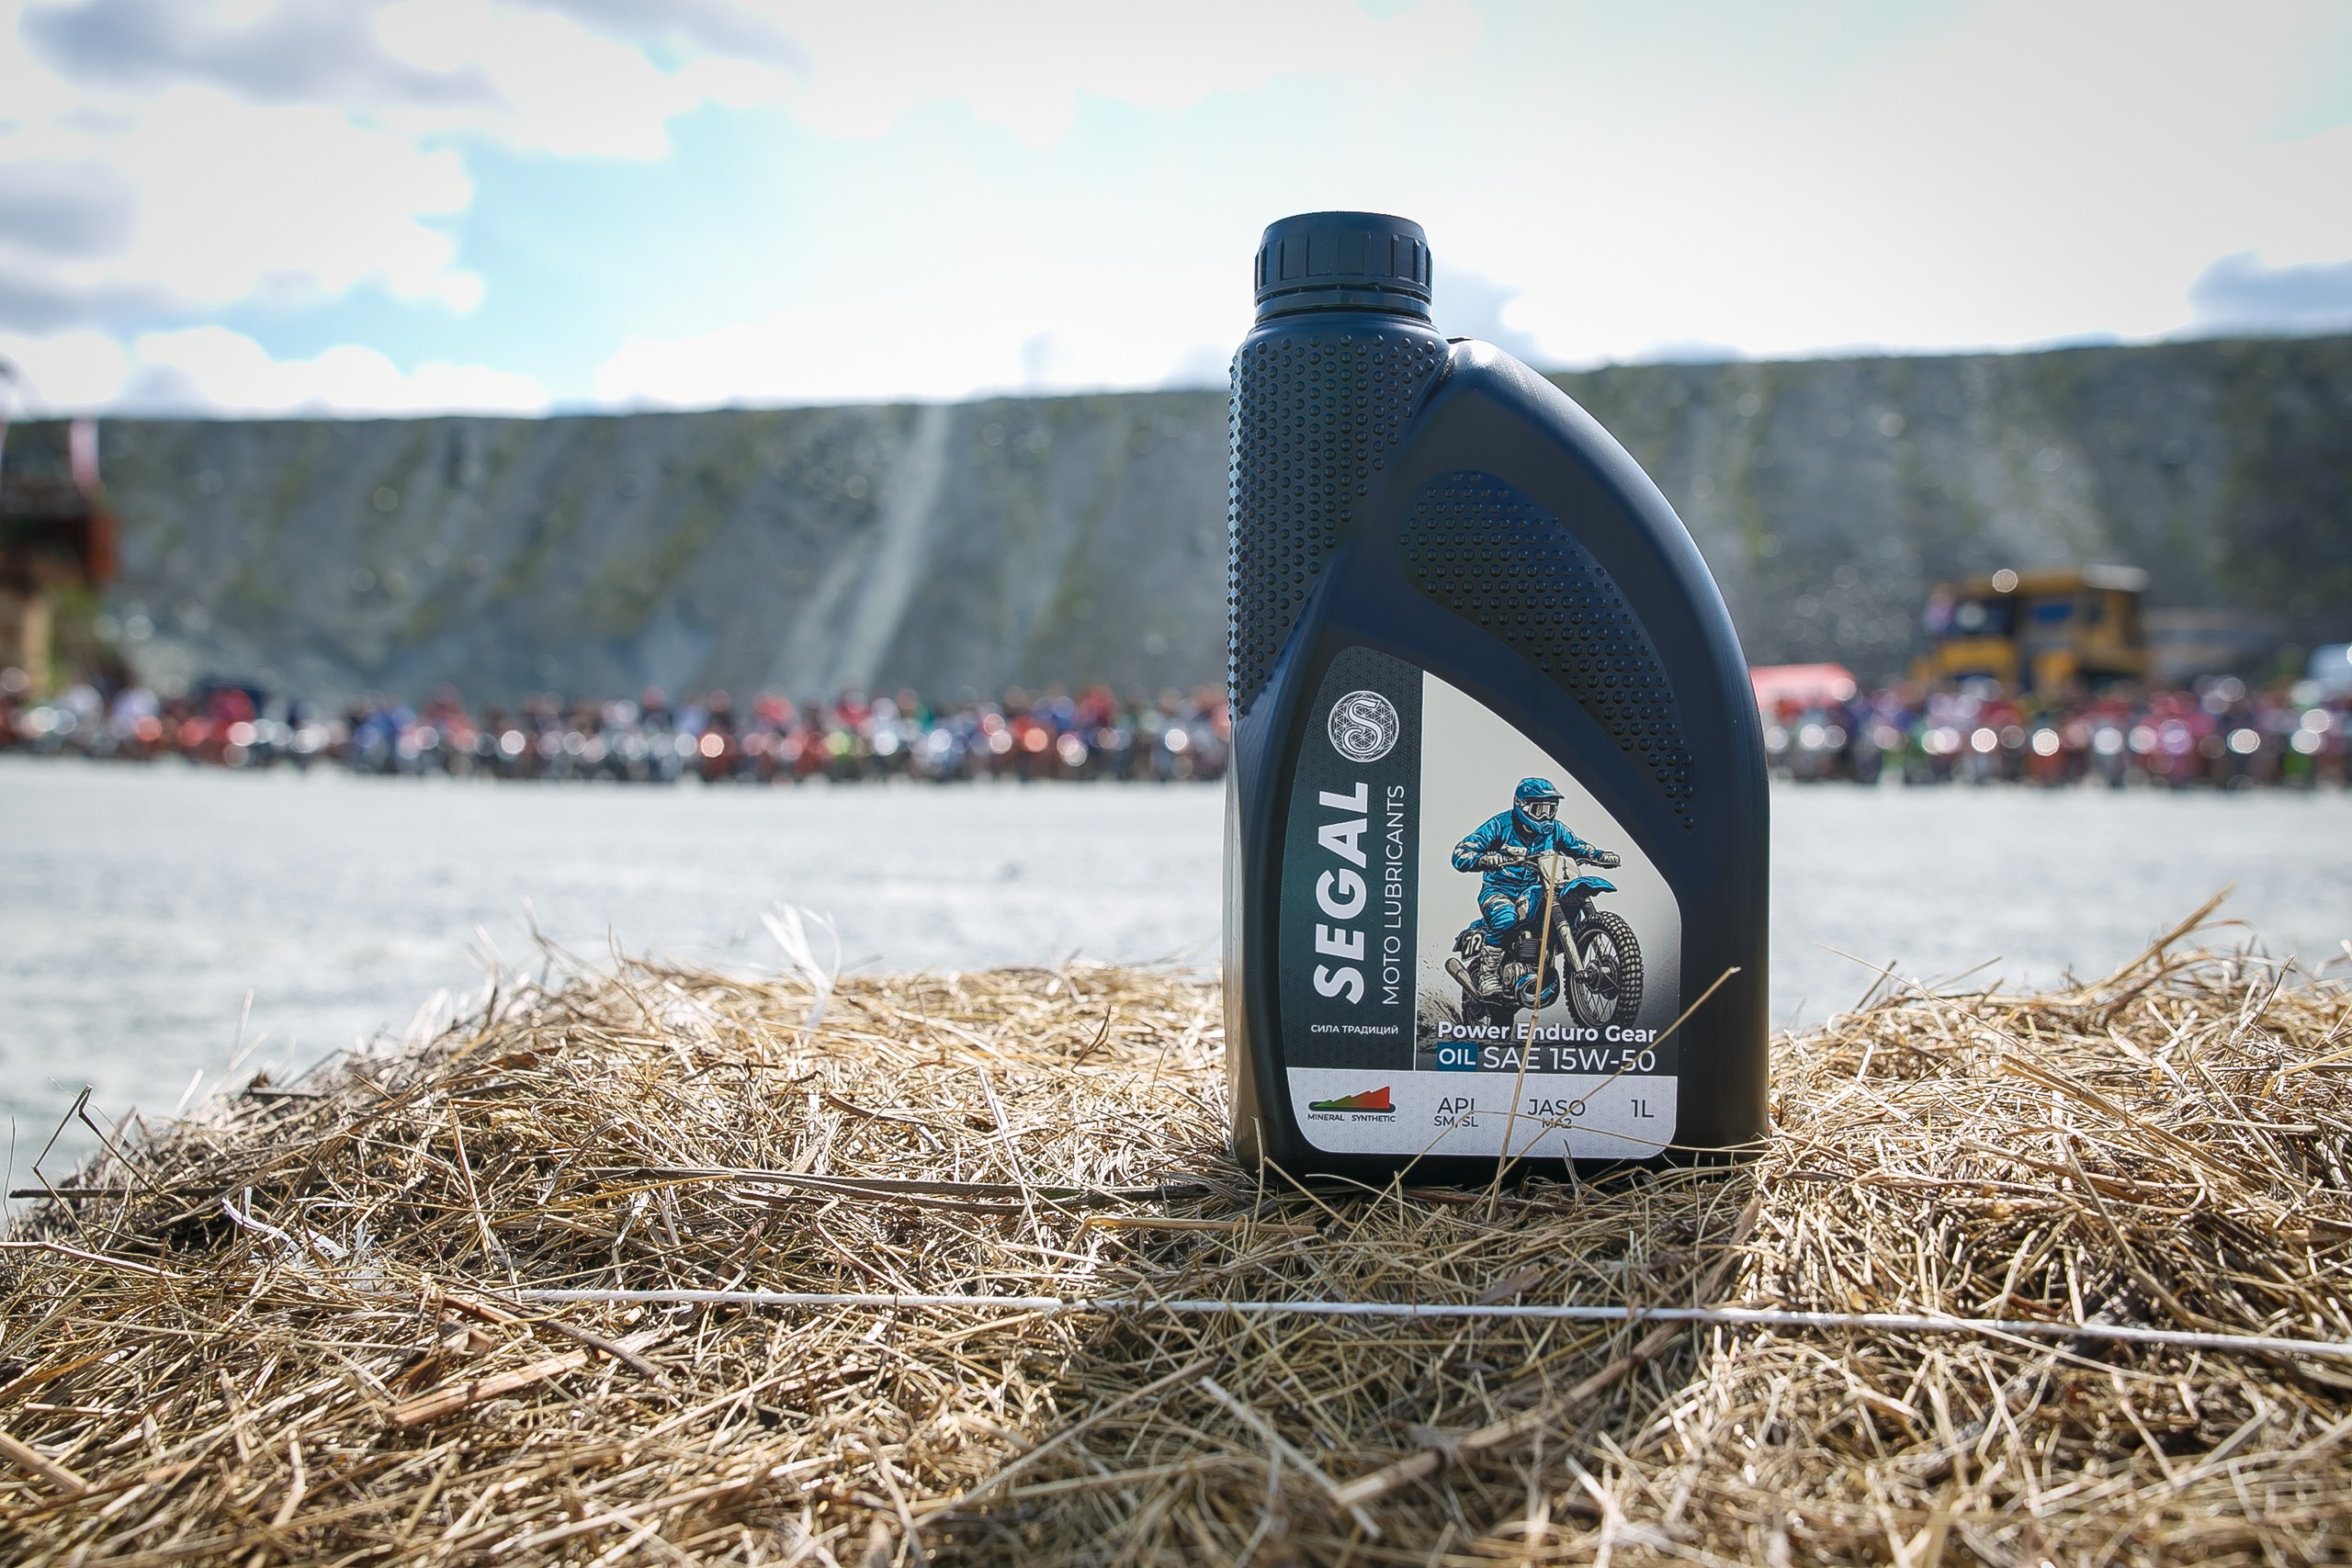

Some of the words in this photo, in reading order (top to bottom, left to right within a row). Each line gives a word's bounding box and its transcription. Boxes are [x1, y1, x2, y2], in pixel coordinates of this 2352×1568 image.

[1384, 784, 1405, 929] LUBRICANTS
[1313, 782, 1368, 1005] SEGAL
[1382, 935, 1401, 1005] MOTO
[1310, 1024, 1340, 1033] СИЛА
[1341, 1024, 1399, 1035] ТРАДИЦИЙ
[1437, 1021, 1510, 1040] Power
[1517, 1022, 1599, 1042] Enduro
[1605, 1024, 1657, 1043] Gear
[1438, 1047, 1476, 1066] OIL
[1483, 1046, 1541, 1070] SAE
[1550, 1047, 1657, 1072] 15W-50
[1436, 1097, 1475, 1115] API
[1527, 1099, 1586, 1116] JASO
[1631, 1099, 1655, 1118] 1L
[1307, 1113, 1345, 1122] MINERAL
[1351, 1114, 1396, 1122] SYNTHETIC
[1462, 1116, 1479, 1128] SL
